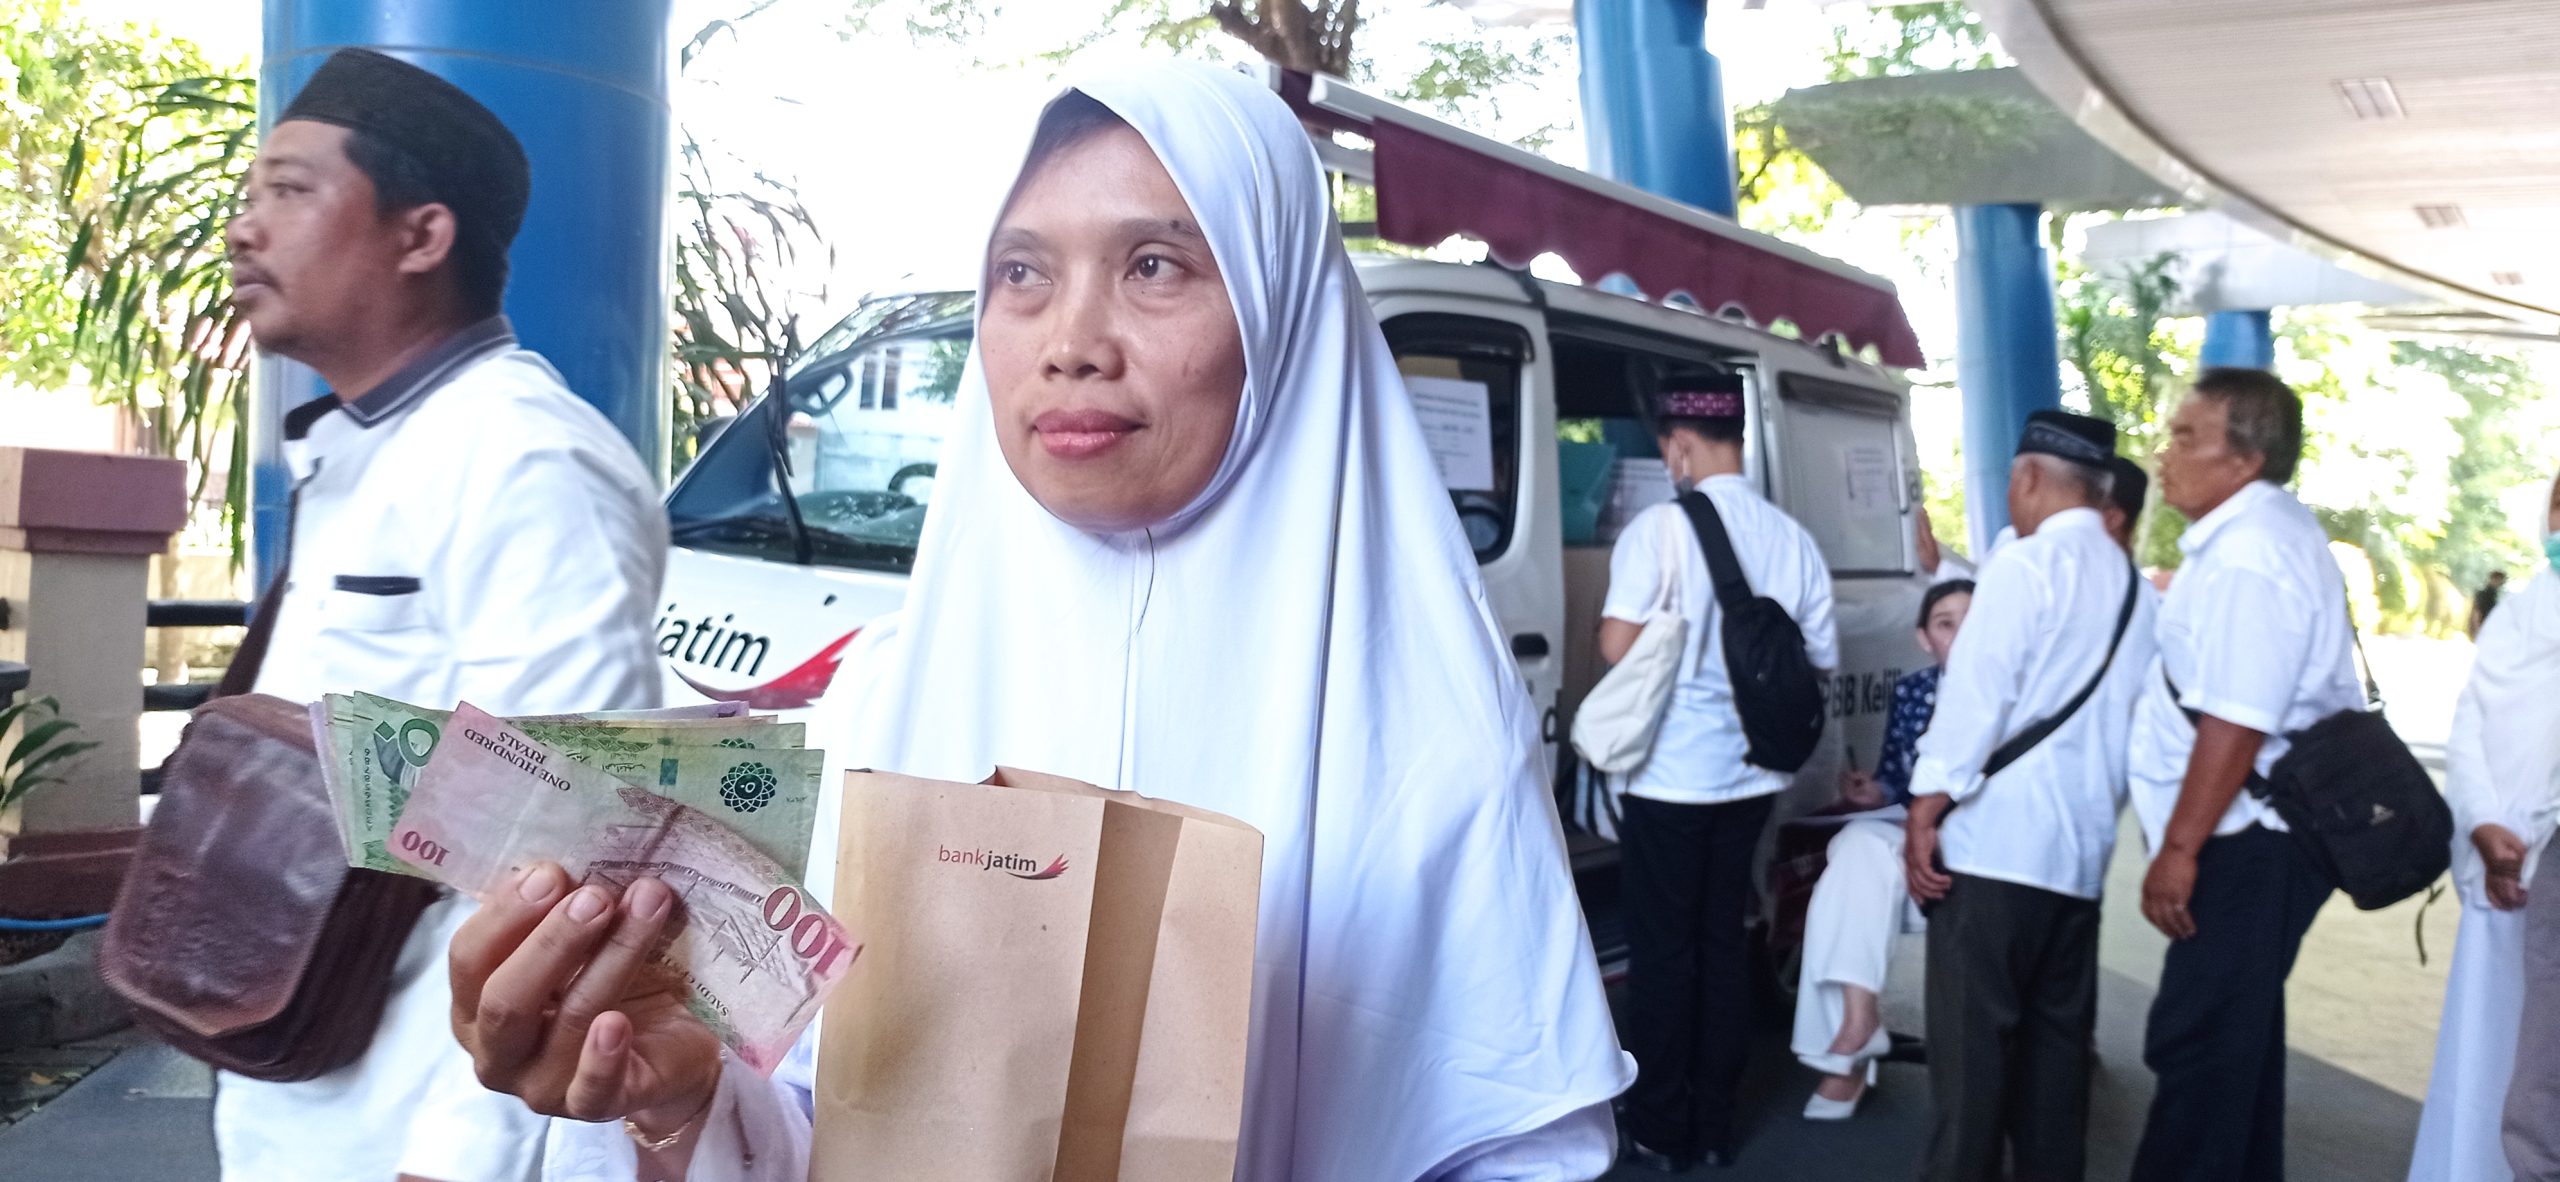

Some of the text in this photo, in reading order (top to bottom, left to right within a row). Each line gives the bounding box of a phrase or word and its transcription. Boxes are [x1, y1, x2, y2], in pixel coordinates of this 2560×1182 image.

[464, 728, 571, 792] ONE HUNDRED
[499, 731, 547, 765] RIYALS
[402, 830, 450, 867] 100
[938, 844, 1037, 872] bankjatim
[763, 886, 849, 980] 100
[696, 983, 730, 1017] SAUDI
